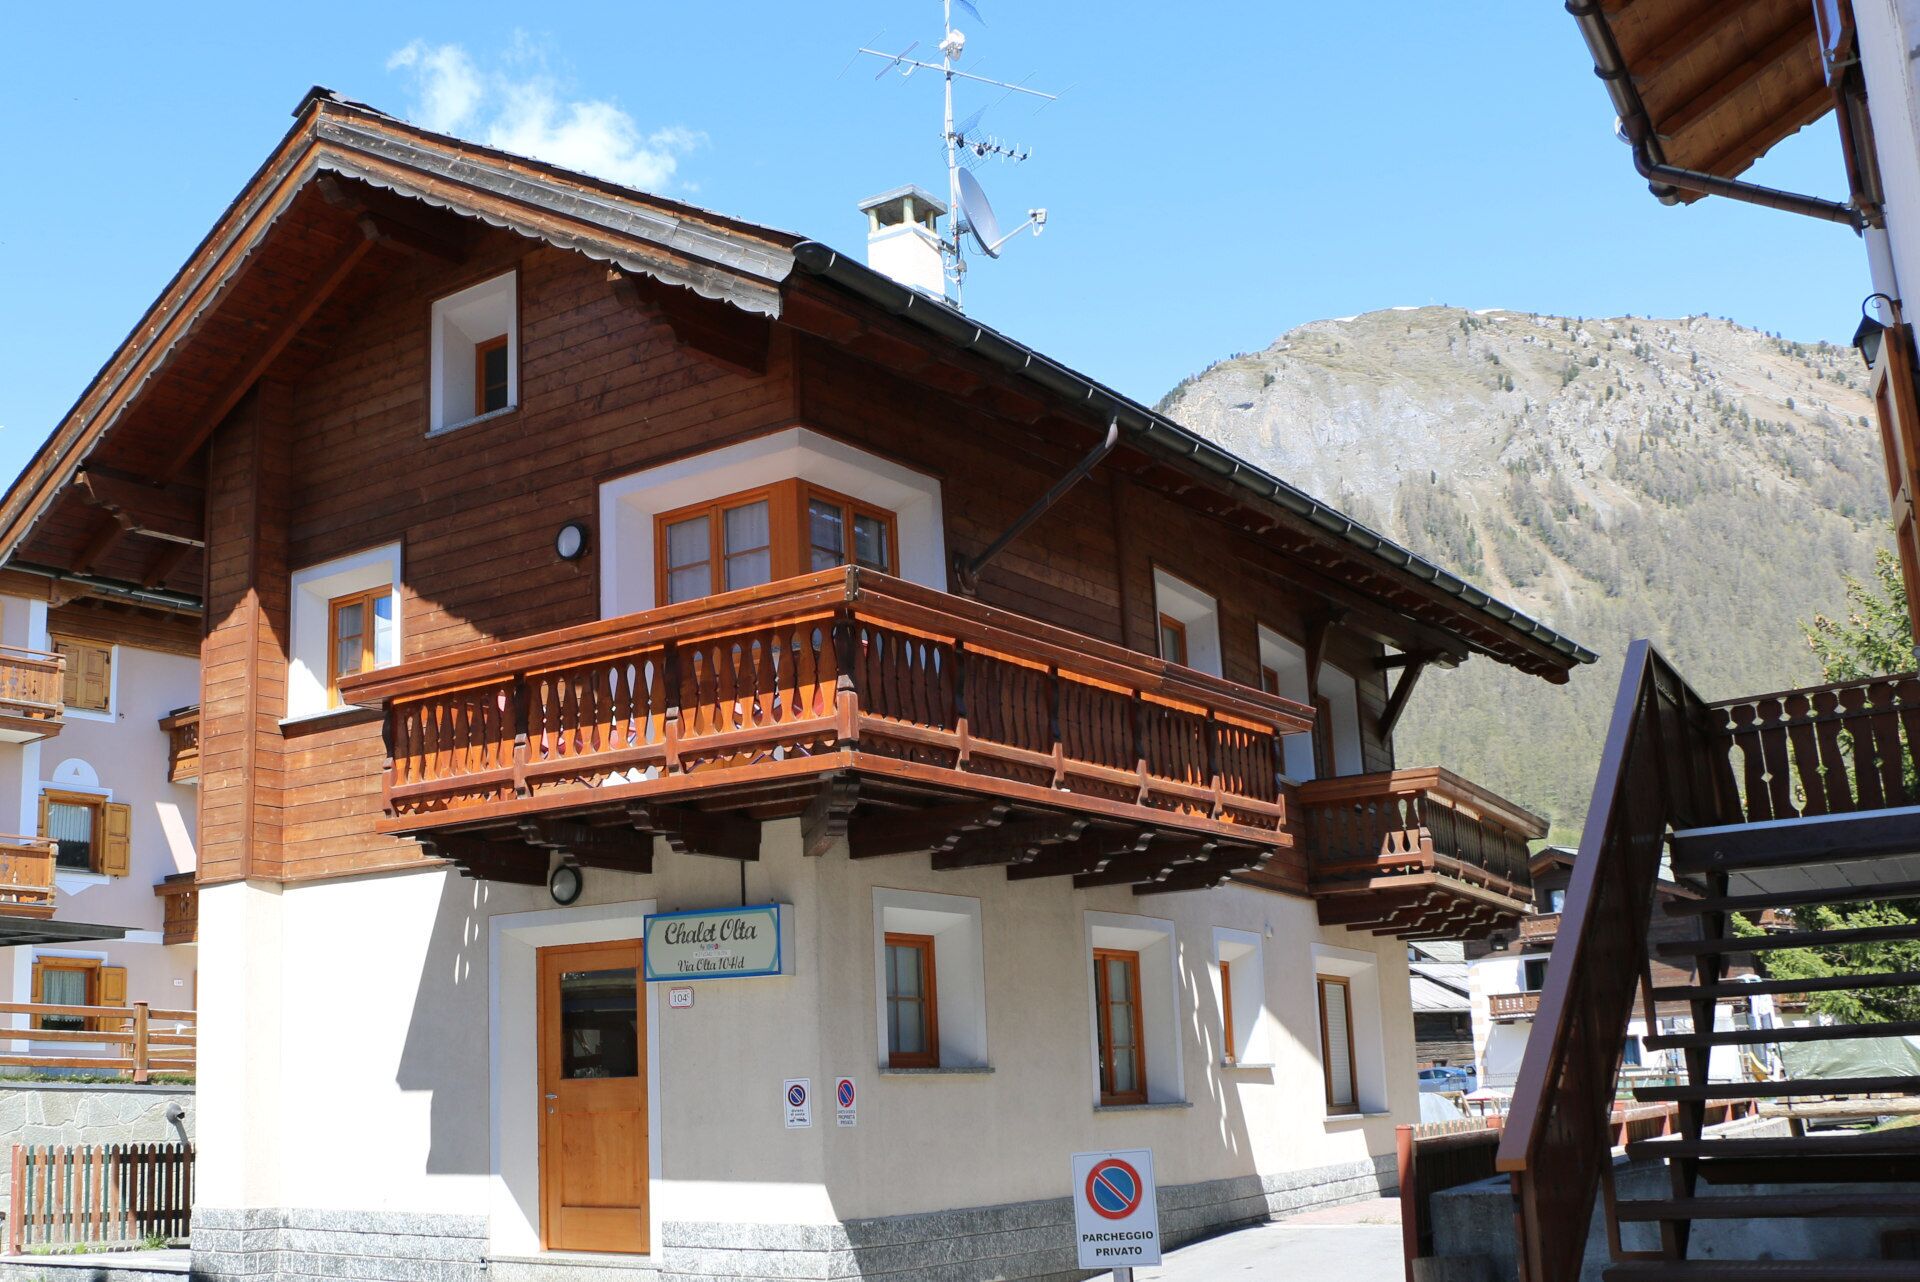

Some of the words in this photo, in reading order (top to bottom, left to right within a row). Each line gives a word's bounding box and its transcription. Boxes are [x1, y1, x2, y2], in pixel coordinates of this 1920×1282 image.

[664, 920, 717, 945] Chalet
[719, 918, 758, 941] Olta
[678, 959, 694, 972] Via
[696, 958, 716, 971] Olta
[1082, 1231, 1154, 1242] PARCHEGGIO
[1095, 1246, 1143, 1257] PRIVATO
